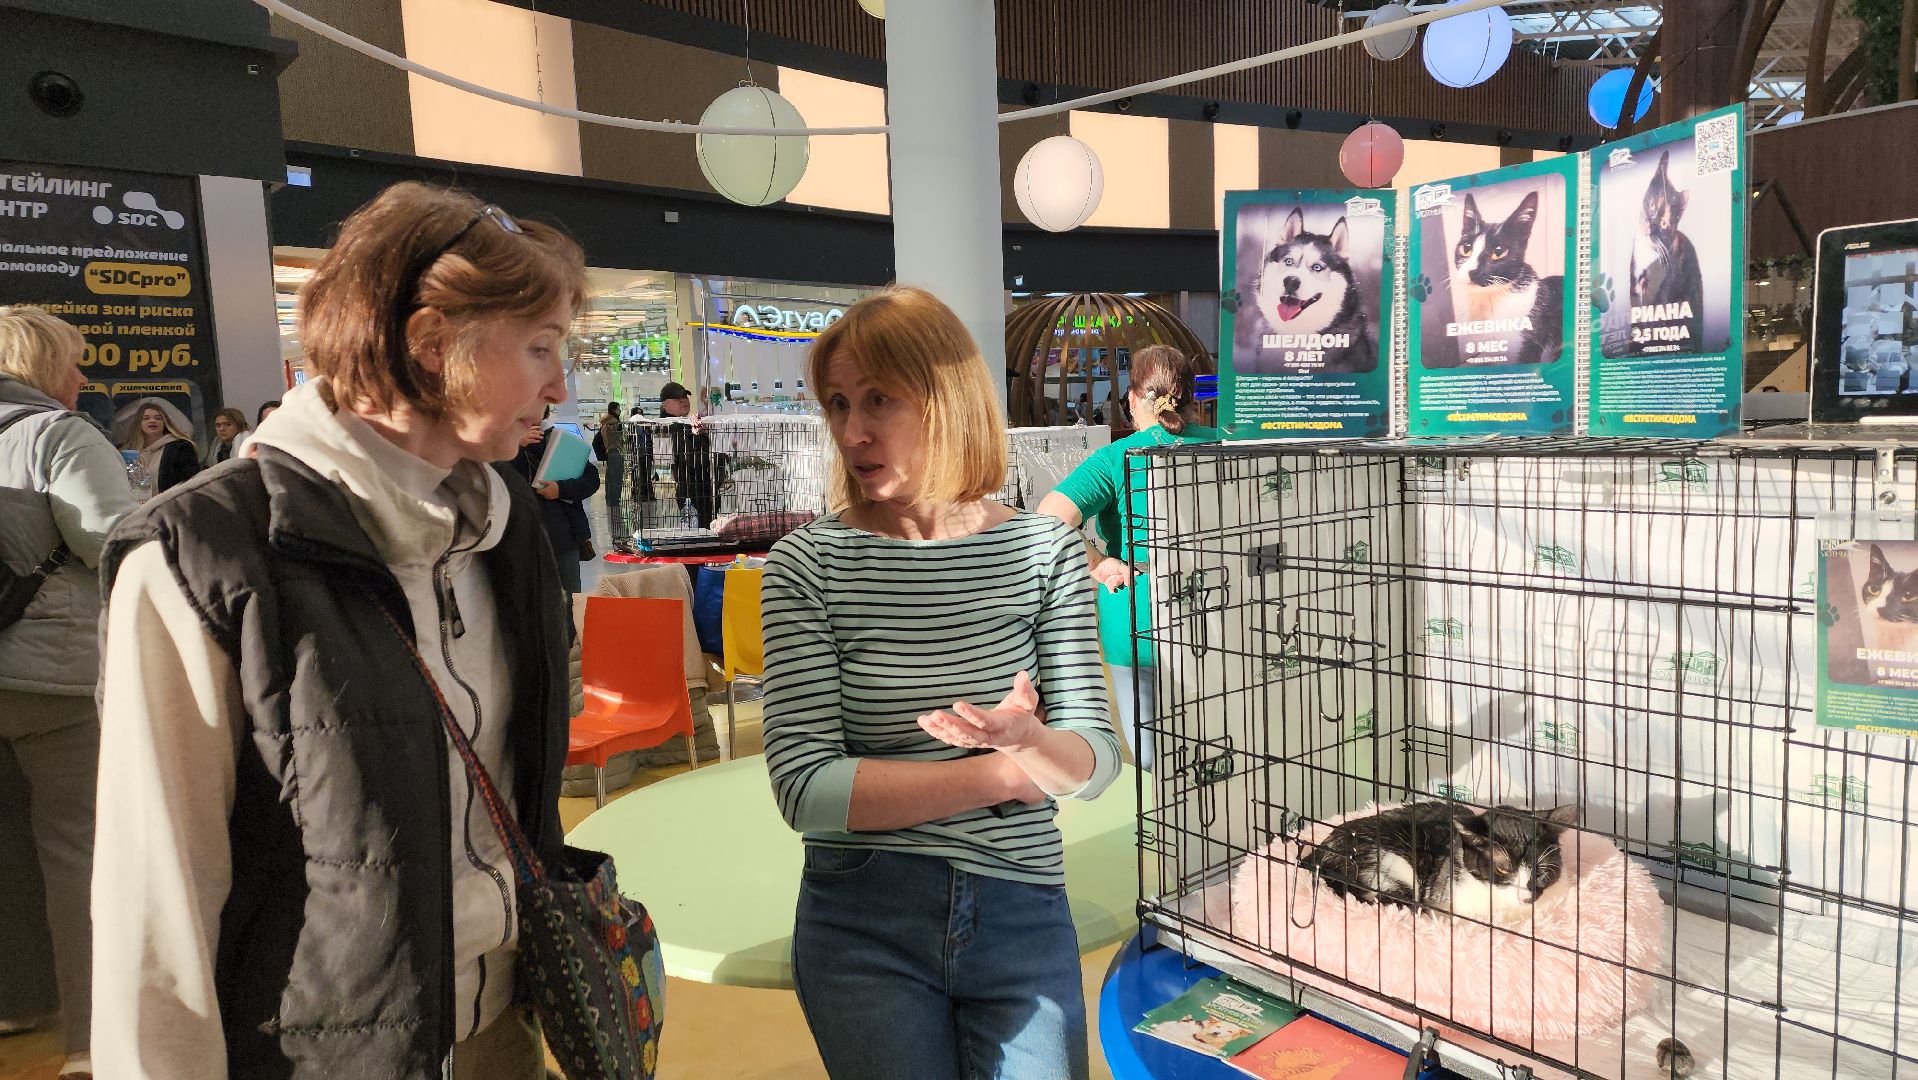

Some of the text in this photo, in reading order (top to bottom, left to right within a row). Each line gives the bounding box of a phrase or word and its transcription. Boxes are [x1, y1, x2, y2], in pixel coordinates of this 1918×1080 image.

[118, 212, 158, 227] SDC
[71, 245, 188, 262] предложение
[103, 304, 136, 316] зон
[140, 306, 194, 319] риска
[1631, 301, 1693, 324] РИАНА
[117, 323, 196, 337] пленкой
[1446, 316, 1533, 337] ЕЖЕВИКА
[1631, 325, 1690, 344] 2,5 ГОДА
[1262, 333, 1350, 351] ШЕЛДОН
[1465, 340, 1508, 354] 8 МЕС
[128, 342, 200, 373] руб.
[1283, 350, 1326, 362] 8 ЛЕТ
[1876, 666, 1886, 677] 8
